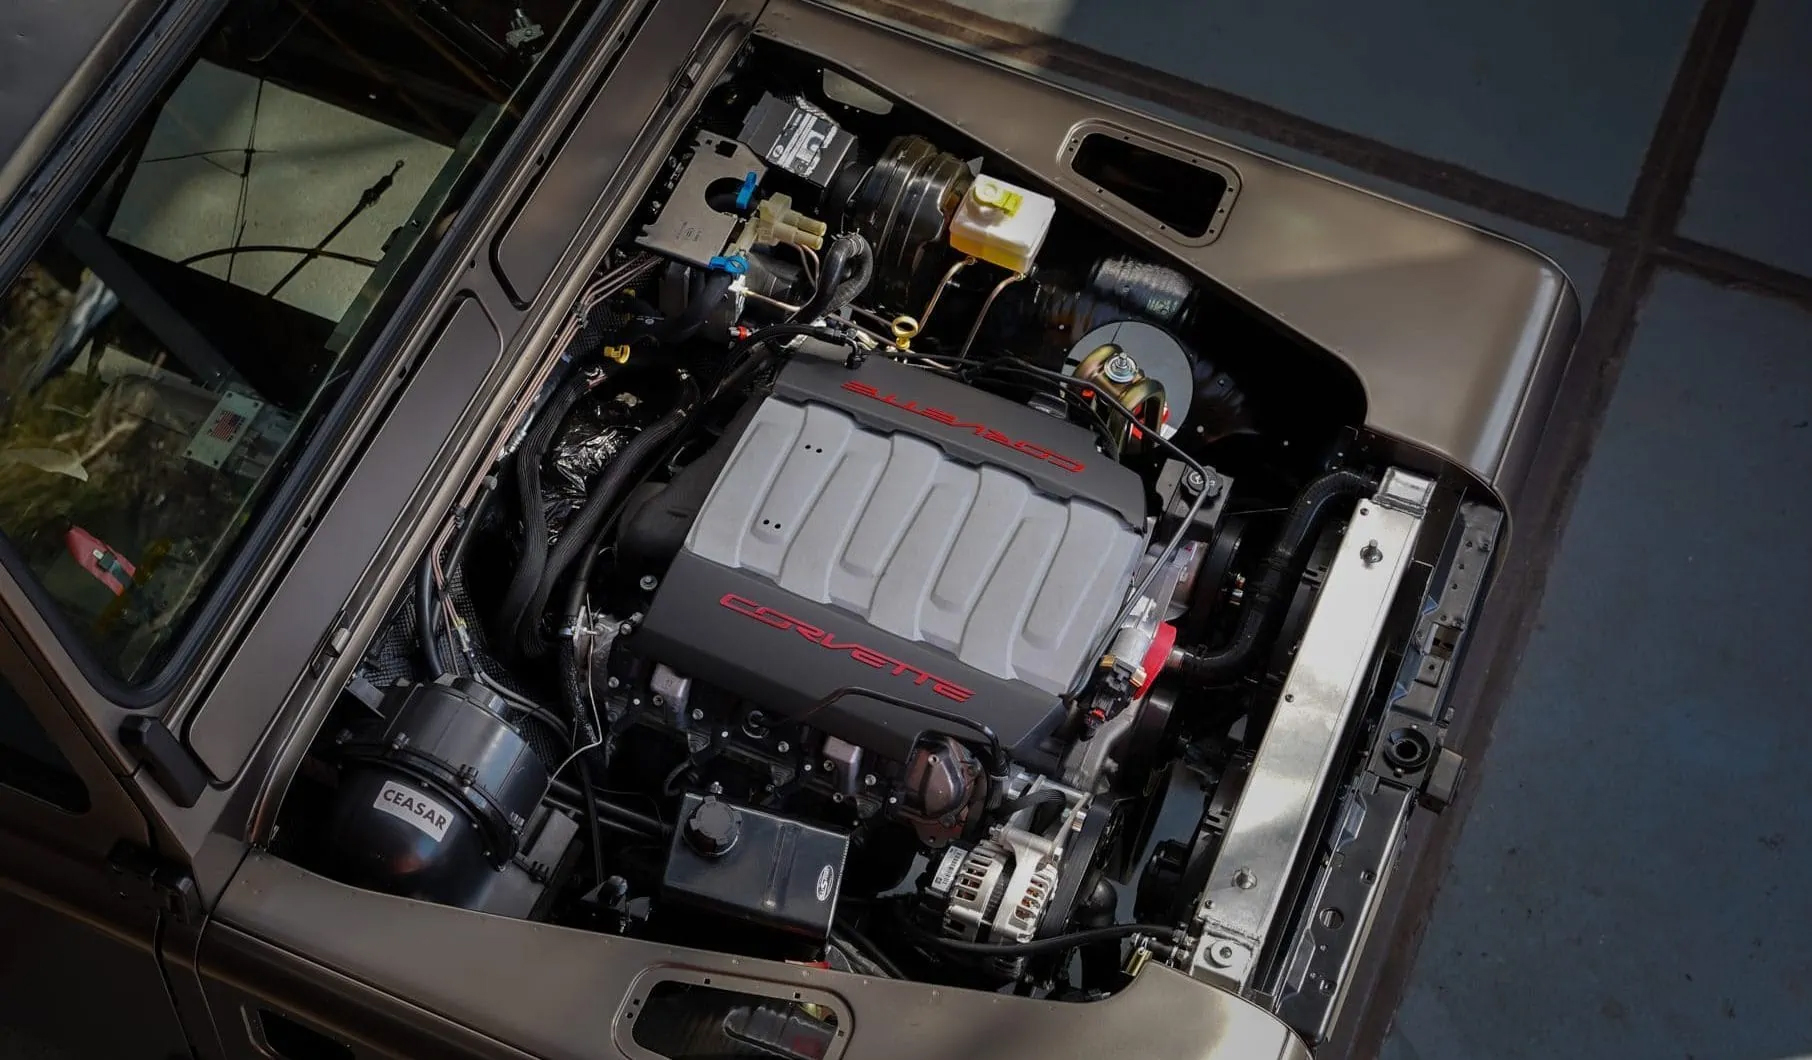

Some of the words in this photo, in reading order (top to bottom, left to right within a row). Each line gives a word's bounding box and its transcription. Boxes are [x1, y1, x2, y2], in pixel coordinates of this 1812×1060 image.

[840, 380, 1086, 472] CORVETTE
[719, 593, 976, 703] CORVETTE
[383, 789, 447, 831] CEASAR
